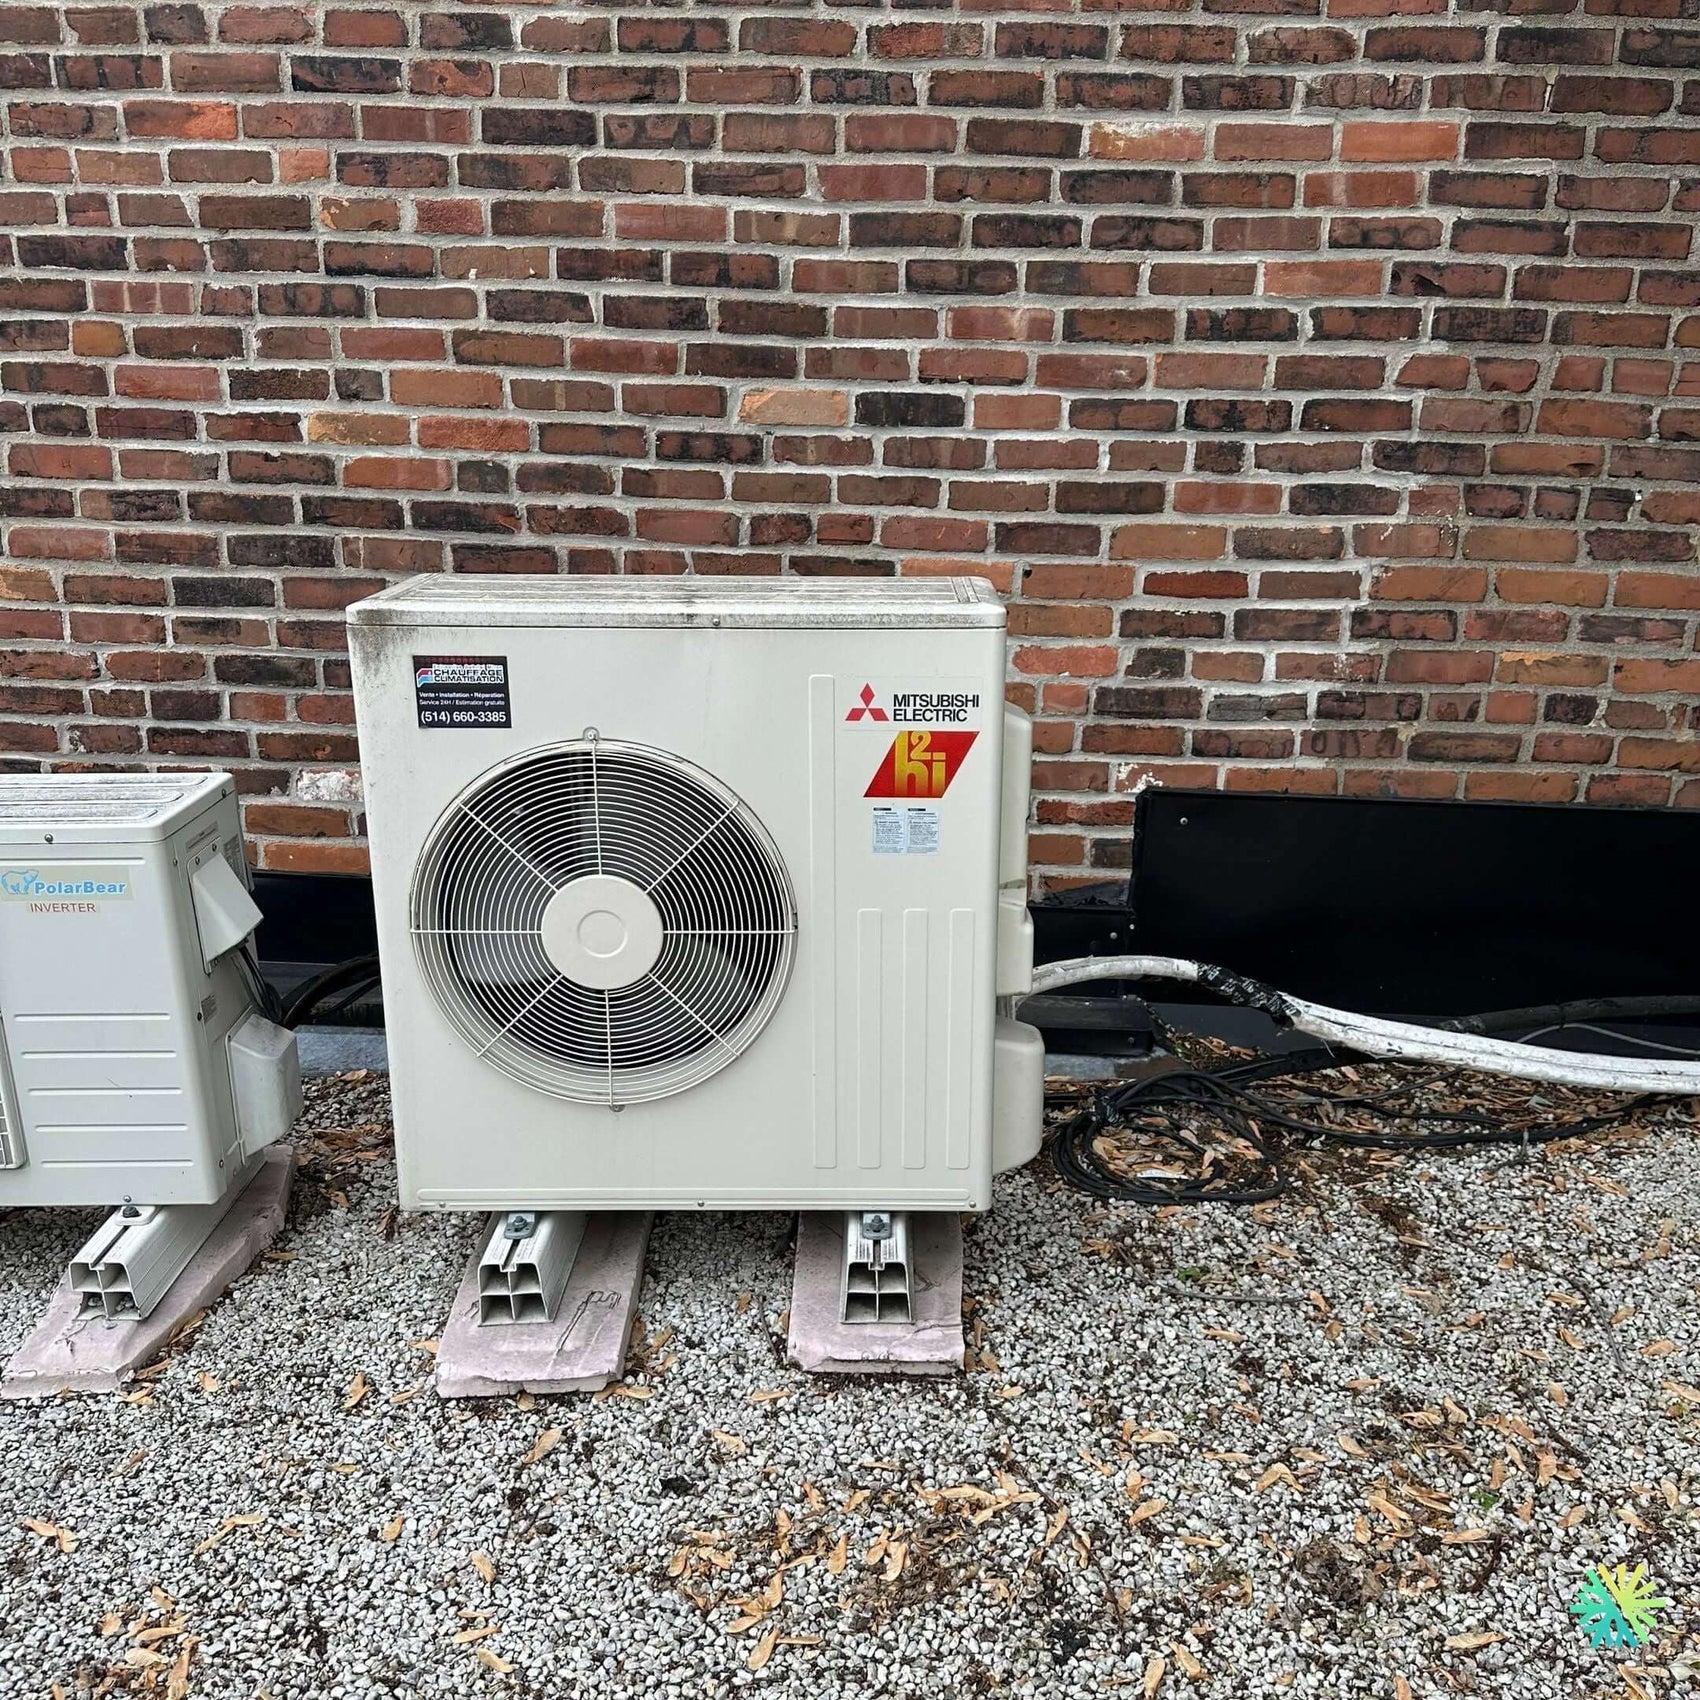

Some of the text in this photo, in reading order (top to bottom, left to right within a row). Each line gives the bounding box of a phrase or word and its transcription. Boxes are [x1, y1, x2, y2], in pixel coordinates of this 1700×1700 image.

[893, 694, 980, 708] MITSUBISHI
[421, 711, 506, 724] (514) 660-3385
[893, 708, 968, 722] ELECTRIC
[34, 881, 126, 895] PolarBear
[30, 903, 97, 913] INVERTER
